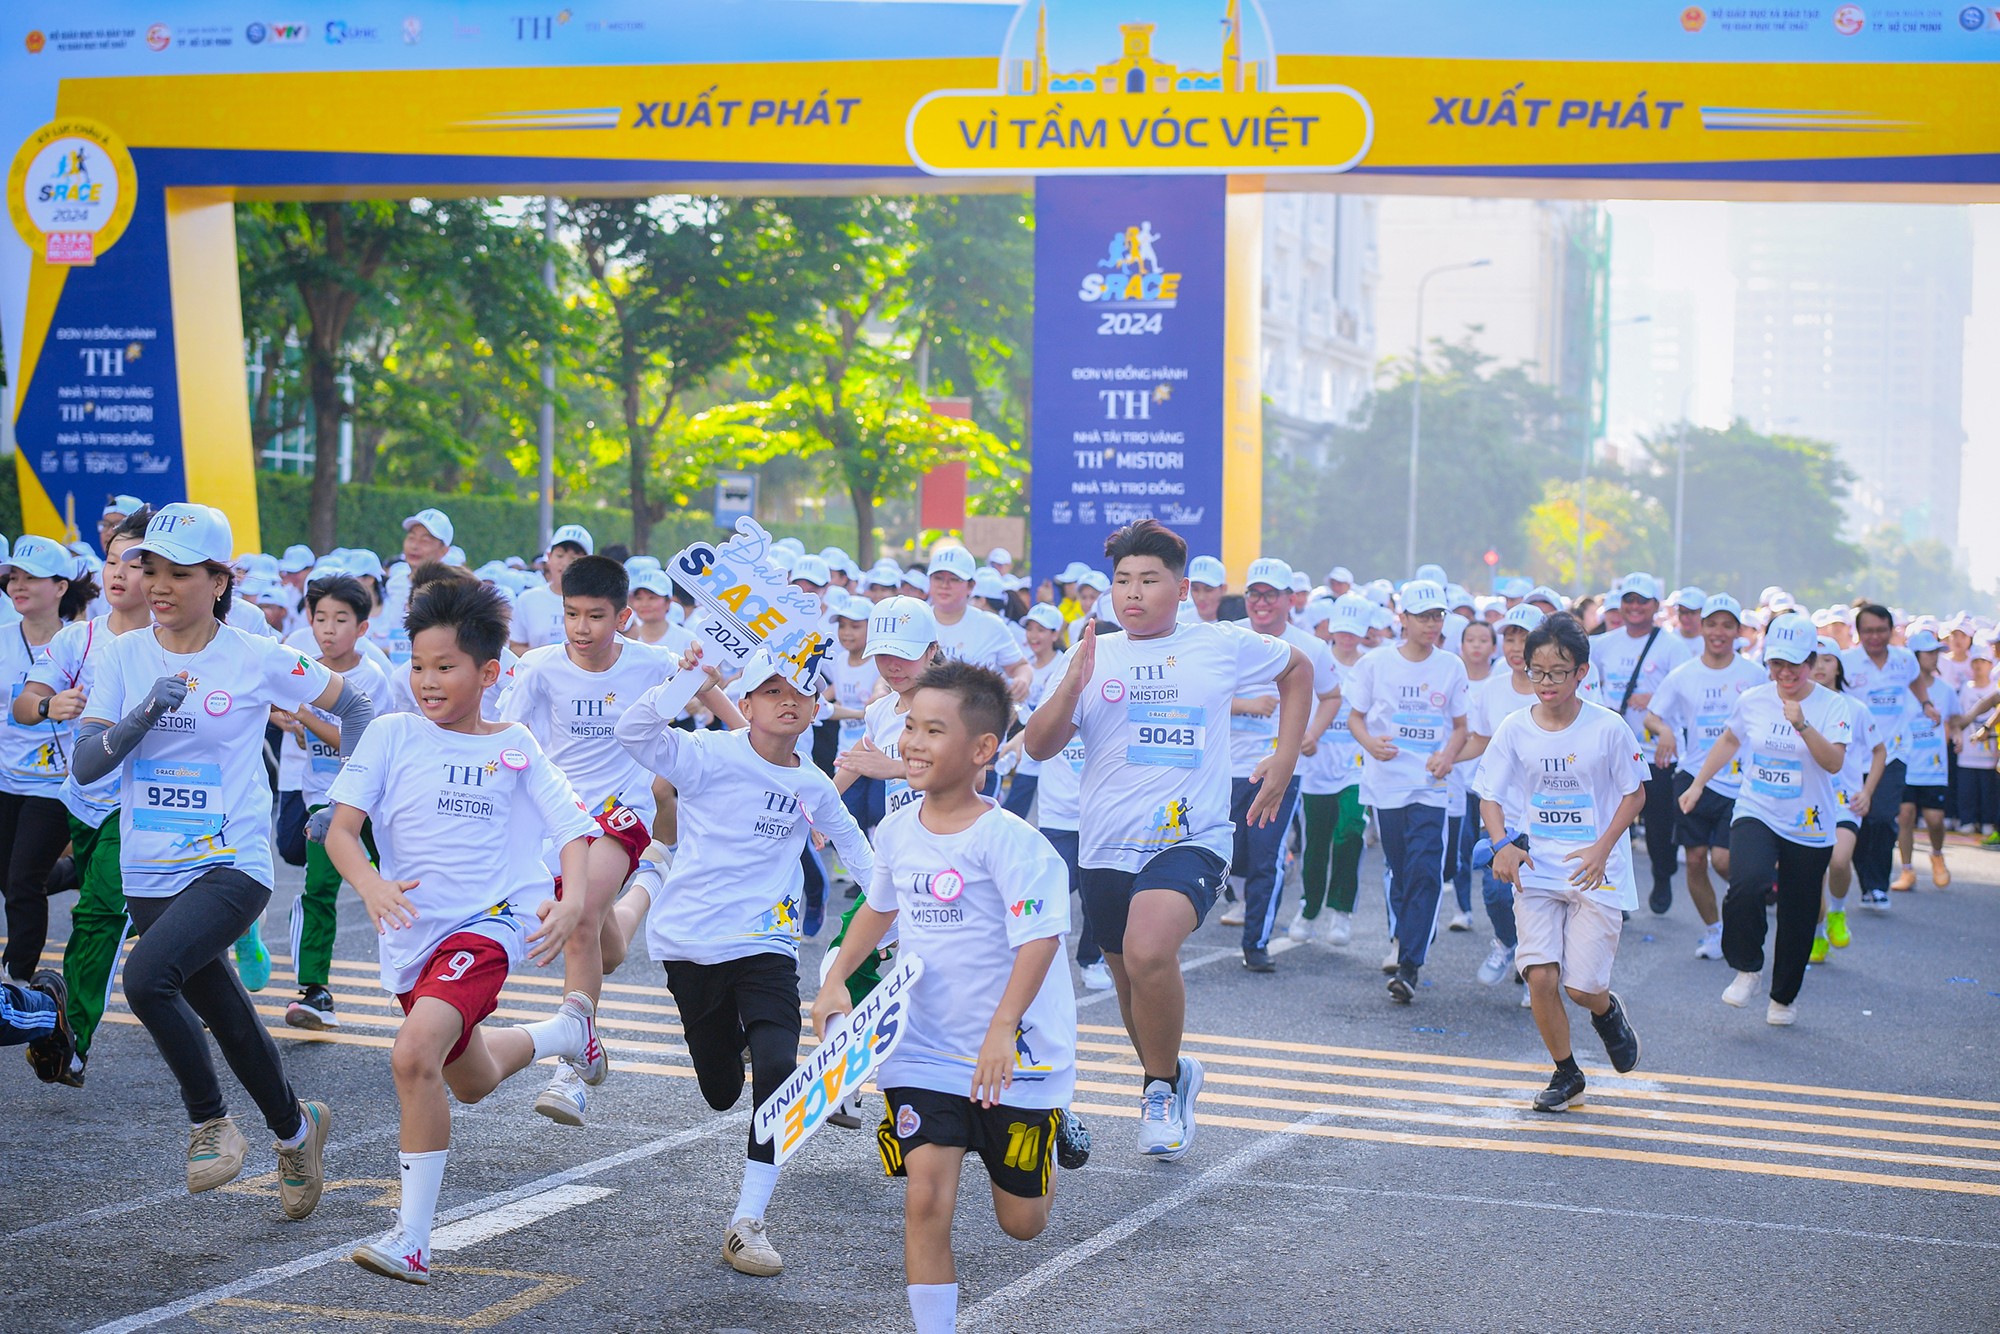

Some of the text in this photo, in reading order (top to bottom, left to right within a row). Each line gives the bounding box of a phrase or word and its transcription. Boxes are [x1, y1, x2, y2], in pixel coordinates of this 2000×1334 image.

[509, 16, 552, 41] TH
[632, 85, 861, 128] XUẤT PHÁT
[1428, 82, 1684, 129] XUẤT PHÁT
[958, 102, 1320, 153] VÌ TẦM VÓC VIỆT
[52, 209, 89, 222] 2024
[1097, 312, 1163, 335] 2024
[79, 348, 125, 376] TH
[58, 404, 153, 422] TH MISTORI
[1099, 389, 1152, 420] TH
[1073, 429, 1101, 443] NHÀ
[1073, 451, 1184, 469] TH MISTORI
[1071, 480, 1099, 494] NHÀ
[150, 514, 178, 533] TH
[1253, 564, 1270, 576] TH
[1415, 588, 1435, 600] TH
[1341, 605, 1358, 617] TH
[875, 617, 898, 633] TH
[1776, 627, 1794, 641] TH
[705, 620, 749, 659] 2024
[1129, 664, 1165, 681] TH
[1129, 689, 1178, 701] MISTORI
[1398, 685, 1420, 698] TH
[572, 699, 604, 716] TH
[1139, 727, 1195, 746] 9043
[1399, 726, 1435, 740] 9033
[1770, 722, 1791, 736] TH
[1540, 757, 1567, 772] TH
[443, 763, 485, 787] TH
[1543, 778, 1580, 789] MISTORI
[1758, 768, 1790, 783] 9076
[147, 786, 208, 810] 9259
[437, 797, 494, 816] MISTORI
[764, 791, 798, 815] TH
[1538, 811, 1582, 824] 9076
[911, 908, 964, 923] MISTORI
[1010, 899, 1044, 918] VTV
[437, 950, 476, 982] 9
[762, 964, 916, 1129] TP. HỒ CHÍ MINH
[1003, 1121, 1041, 1171] 10
